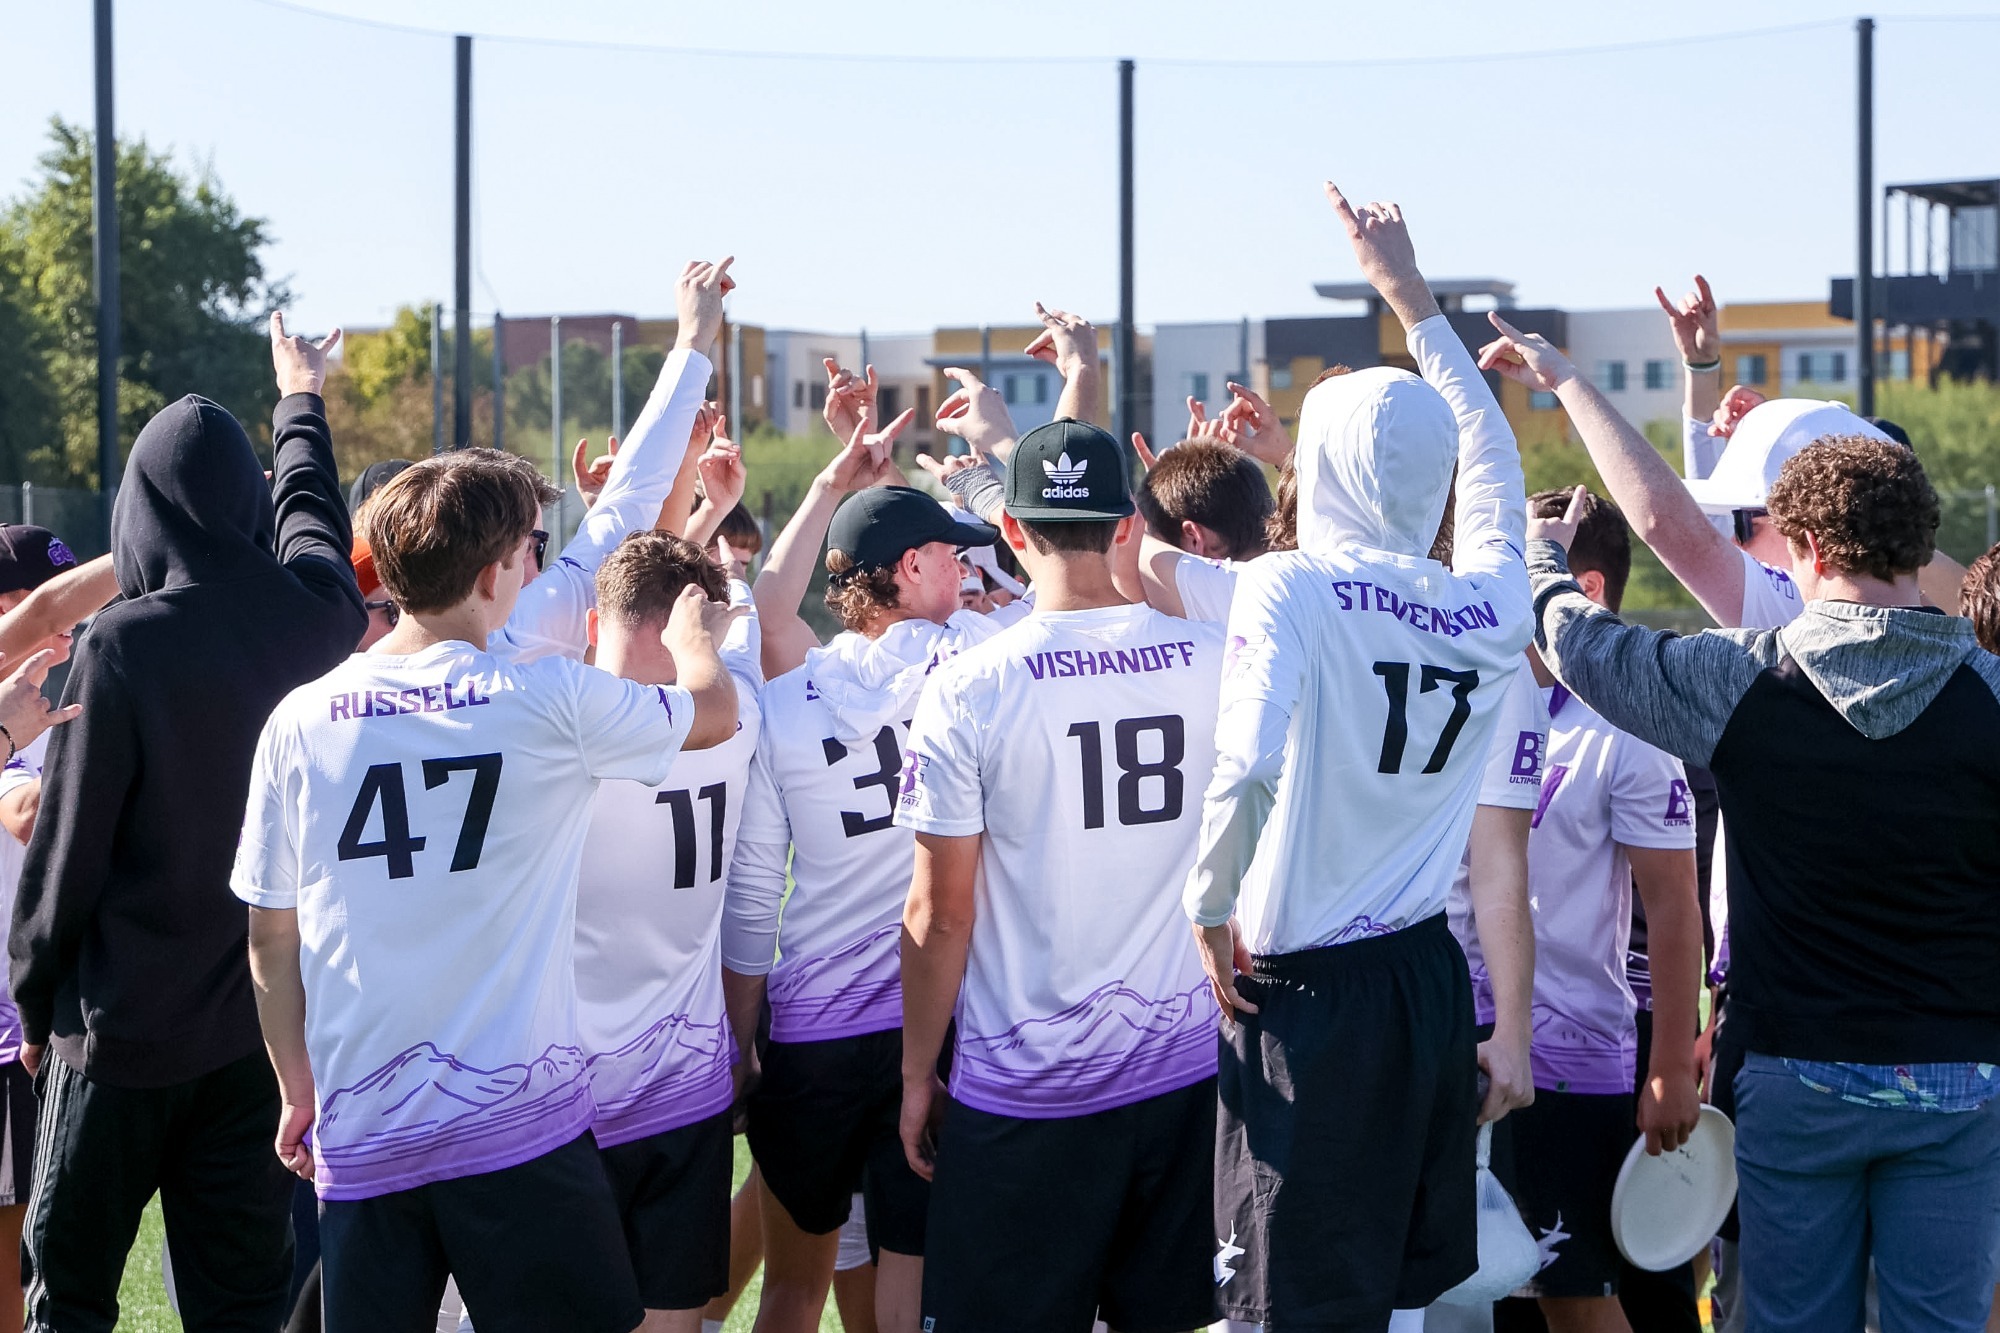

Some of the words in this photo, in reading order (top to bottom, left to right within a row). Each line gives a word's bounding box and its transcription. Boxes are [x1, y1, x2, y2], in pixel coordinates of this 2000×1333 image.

[1042, 485, 1090, 499] adidas
[1331, 580, 1500, 638] STEVENSON
[329, 679, 491, 722] RUSSELL
[1022, 640, 1196, 681] VISHANOFF
[1372, 661, 1480, 775] 17
[821, 718, 913, 839] 3
[1066, 714, 1185, 830] 18
[1509, 776, 1542, 786] ULTIMAT
[337, 752, 504, 880] 47
[655, 781, 727, 890] 11
